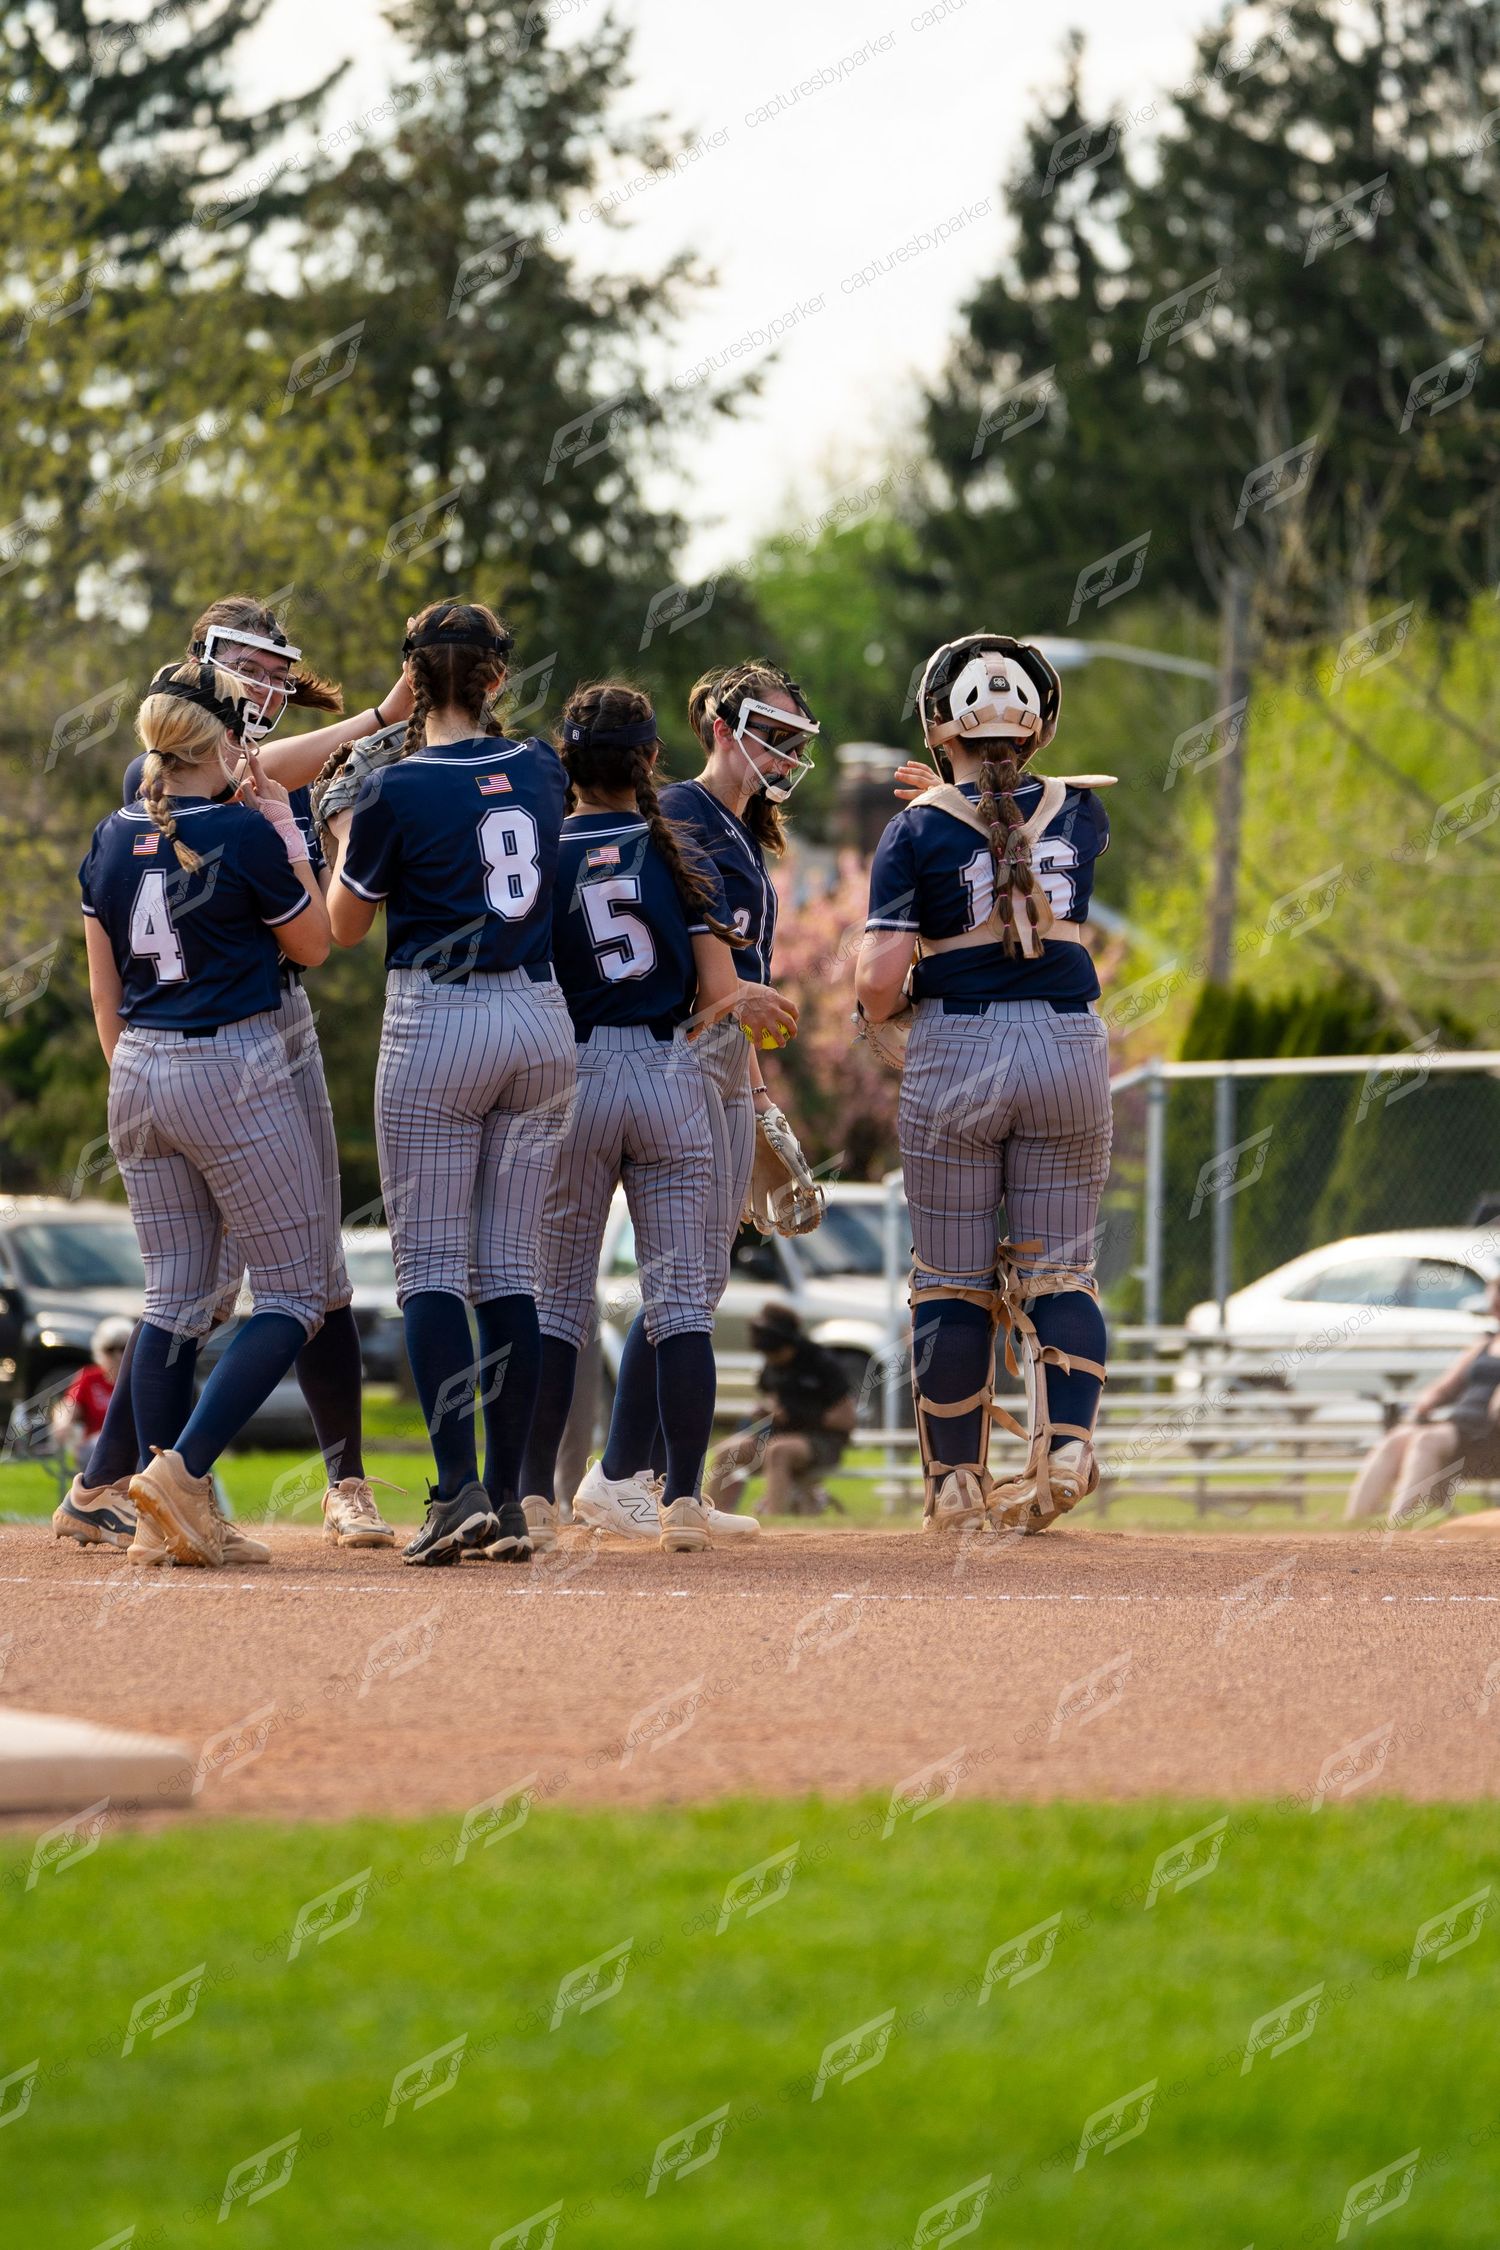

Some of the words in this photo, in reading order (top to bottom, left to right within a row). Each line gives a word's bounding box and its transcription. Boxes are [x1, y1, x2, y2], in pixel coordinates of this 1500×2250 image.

[476, 804, 541, 922] 8
[128, 868, 189, 985] 4
[576, 875, 658, 984] 5
